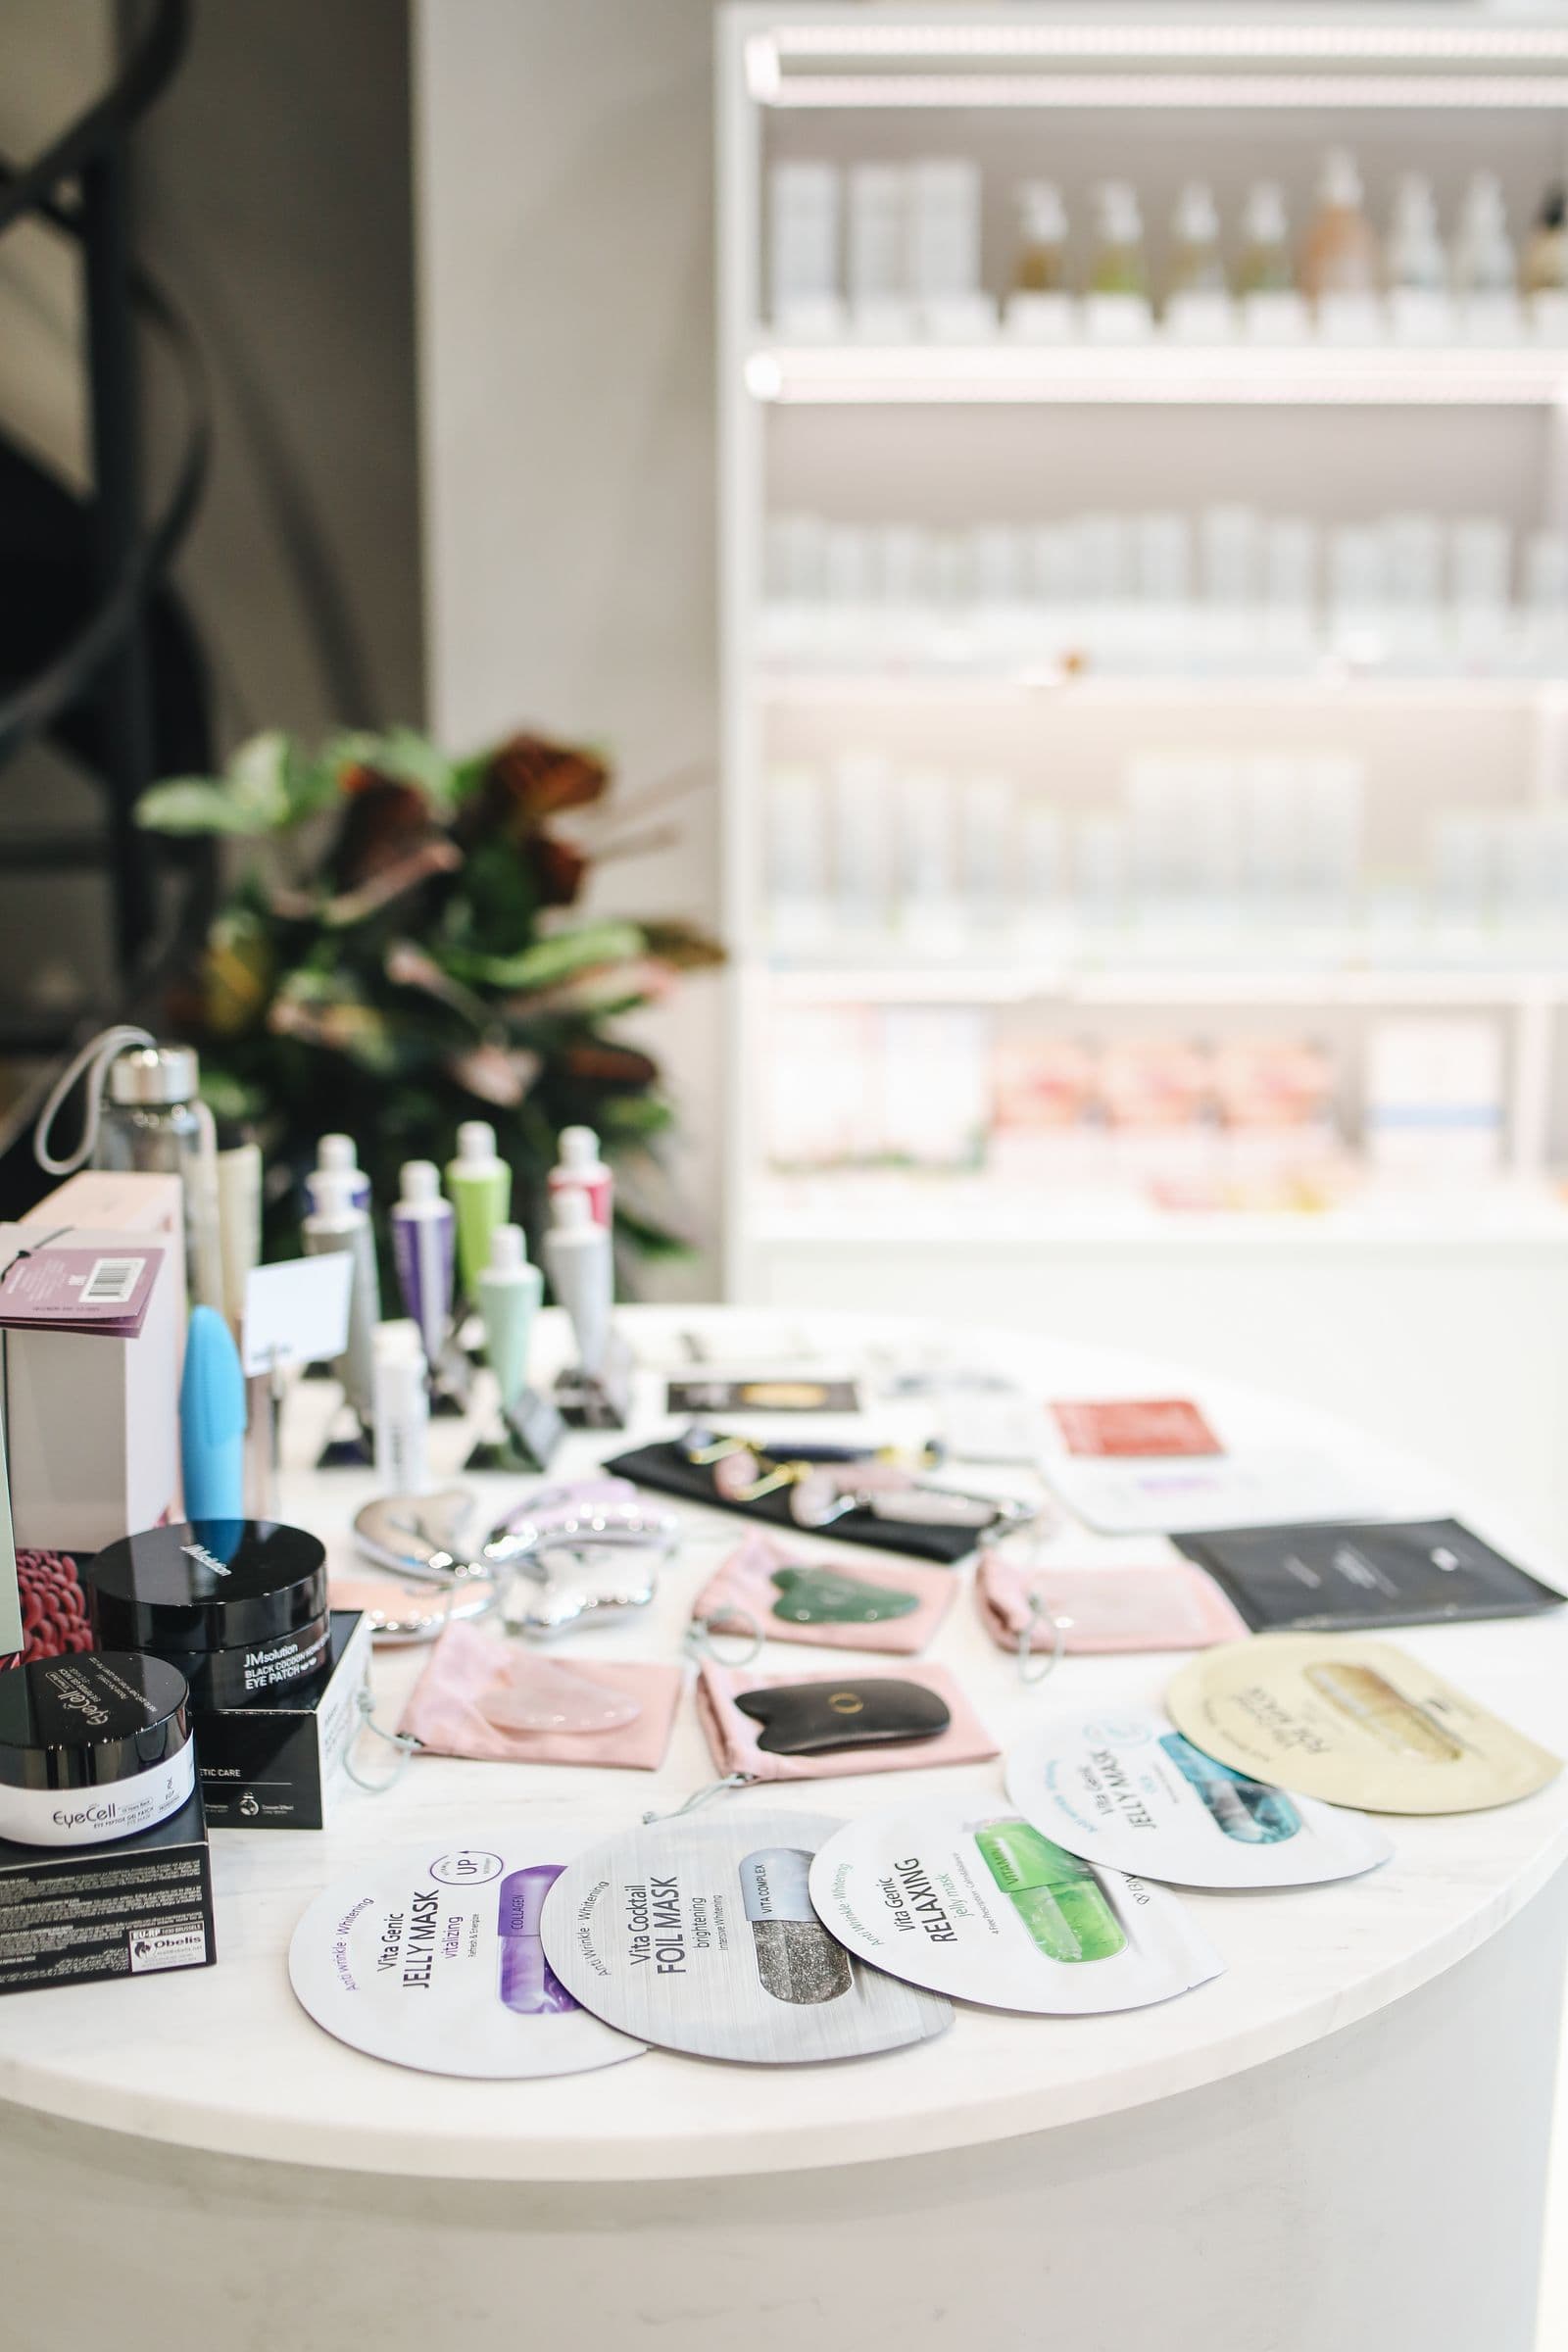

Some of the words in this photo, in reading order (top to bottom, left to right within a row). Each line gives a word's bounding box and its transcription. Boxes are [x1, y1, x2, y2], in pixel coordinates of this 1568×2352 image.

[243, 1643, 298, 1668] JMsolution
[244, 1665, 273, 1679] BLACK
[274, 1653, 305, 1670] COCOON
[245, 1676, 267, 1690] EYE
[269, 1664, 300, 1684] PATCH
[58, 1690, 109, 1725] EyeCell
[218, 1769, 241, 1778] CARE
[53, 1803, 116, 1829] EyeCell
[1115, 1790, 1157, 1829] JELLY
[457, 1859, 478, 1876] UP
[754, 1864, 769, 1896] COMPLEX
[833, 1863, 853, 1899] Whitening
[876, 1877, 904, 1908] Genic
[894, 1857, 958, 1942] RELAXING
[935, 1873, 959, 1897] mask
[336, 1897, 374, 1936] Whitening
[409, 1889, 439, 1940] MASK
[510, 1894, 525, 1930] COLLAGEN
[577, 1881, 610, 1921] Whitening
[624, 1885, 650, 1932] Cocktail
[650, 1876, 682, 1929] MASK
[711, 1894, 725, 1926] Whitening
[760, 1897, 773, 1914] VITA
[949, 1898, 975, 1919] jelly
[381, 1913, 404, 1942] Genic
[689, 1897, 711, 1949] brightening
[839, 1903, 863, 1936] Wrinkle
[894, 1910, 915, 1932] Vita
[155, 1936, 202, 1948] Obelis
[441, 1916, 464, 1959] vitalizing
[576, 1927, 597, 1960] Wrinkle
[628, 1936, 652, 1966] Vita
[717, 1926, 729, 1951] Intensive
[860, 1932, 885, 1946] Anti
[376, 1945, 399, 1972] Vita
[403, 1943, 433, 1988] JELLY
[588, 1958, 612, 1977] Anti
[655, 1934, 686, 1975] FOIL
